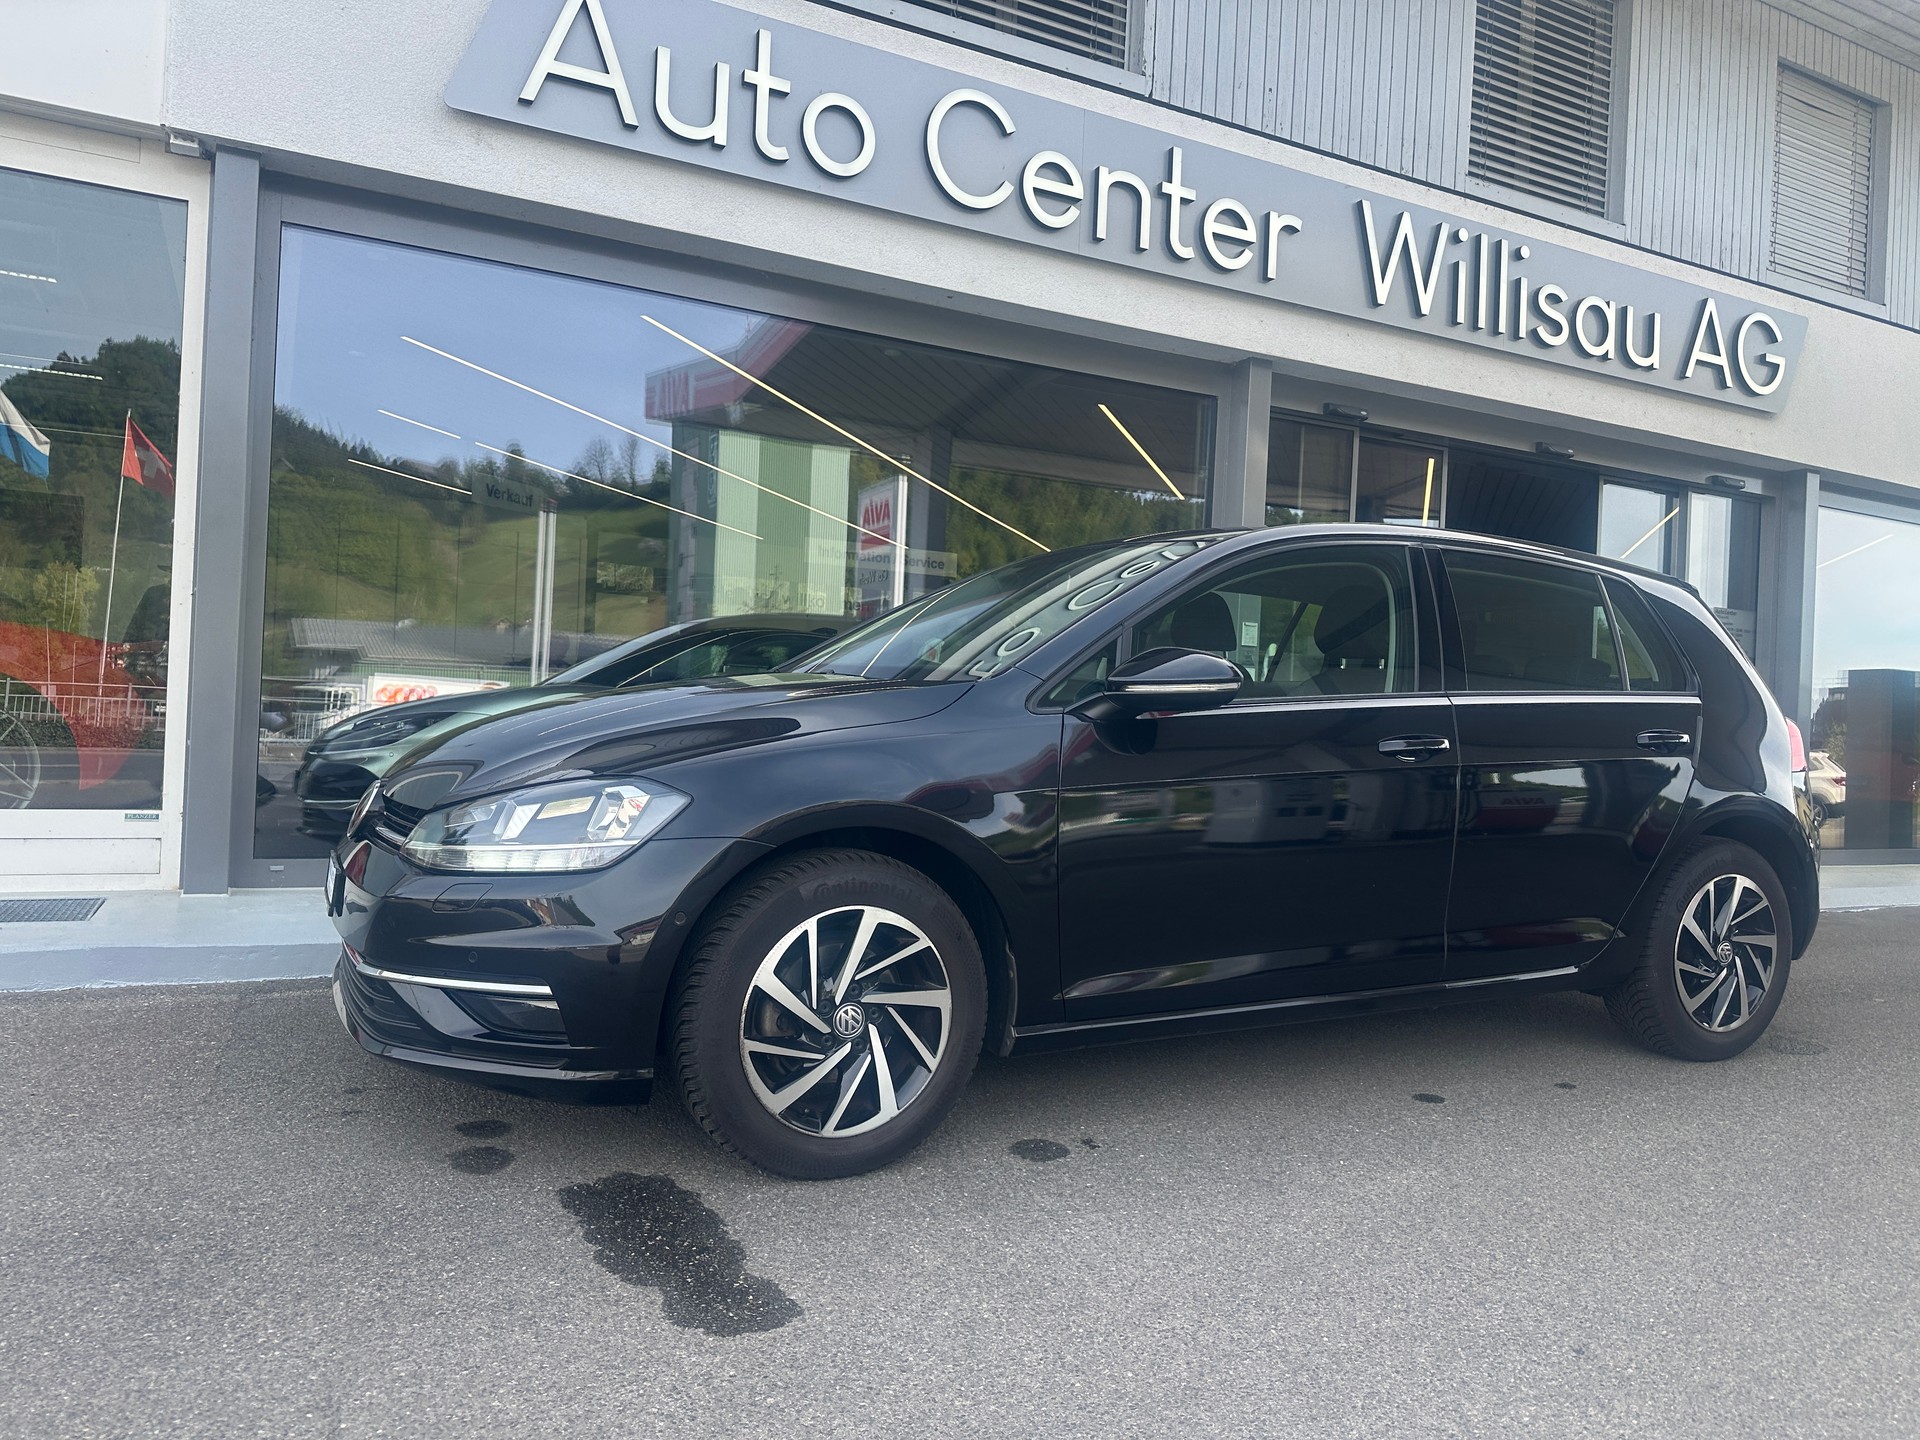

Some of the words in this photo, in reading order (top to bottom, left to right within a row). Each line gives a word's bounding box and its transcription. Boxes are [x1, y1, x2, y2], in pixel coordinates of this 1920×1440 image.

[518, 0, 876, 177] Auto
[924, 88, 1302, 282] Center
[1357, 199, 1661, 370] Willisau
[1681, 298, 1786, 396] AG
[486, 483, 533, 506] Verkauf
[903, 555, 945, 570] Service
[813, 877, 912, 902] Continental
